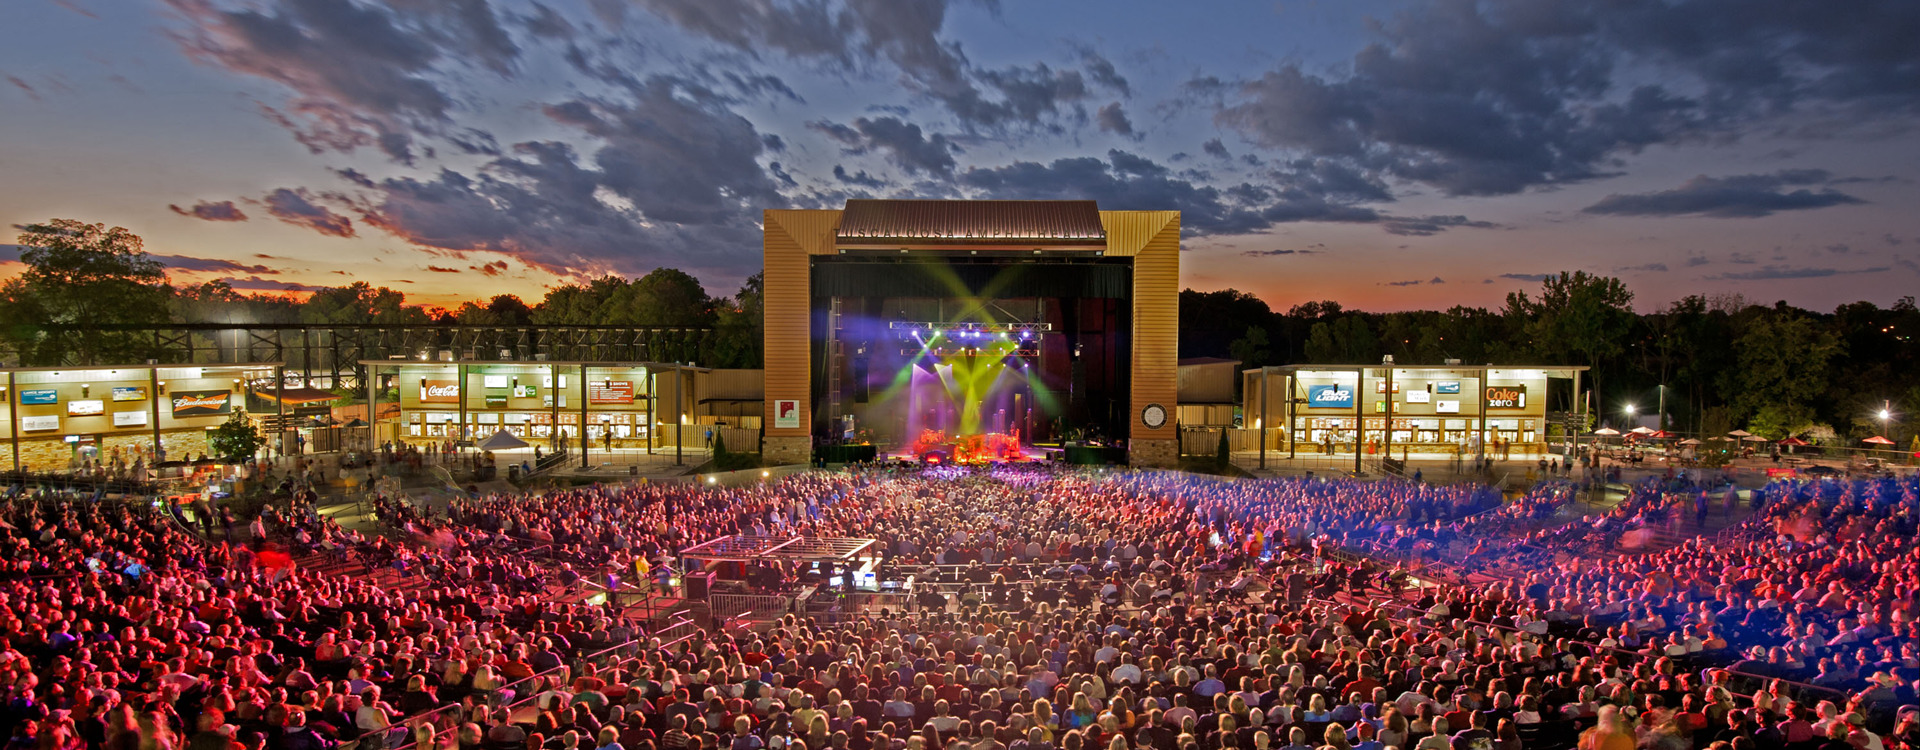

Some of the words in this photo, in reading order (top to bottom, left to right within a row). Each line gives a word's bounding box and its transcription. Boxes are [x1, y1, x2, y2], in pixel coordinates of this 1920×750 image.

[833, 229, 955, 238] TUSCALOOSA
[966, 229, 1107, 238] AMPHITHEATER
[1486, 388, 1518, 400] Coke
[173, 398, 227, 408] Budweiser
